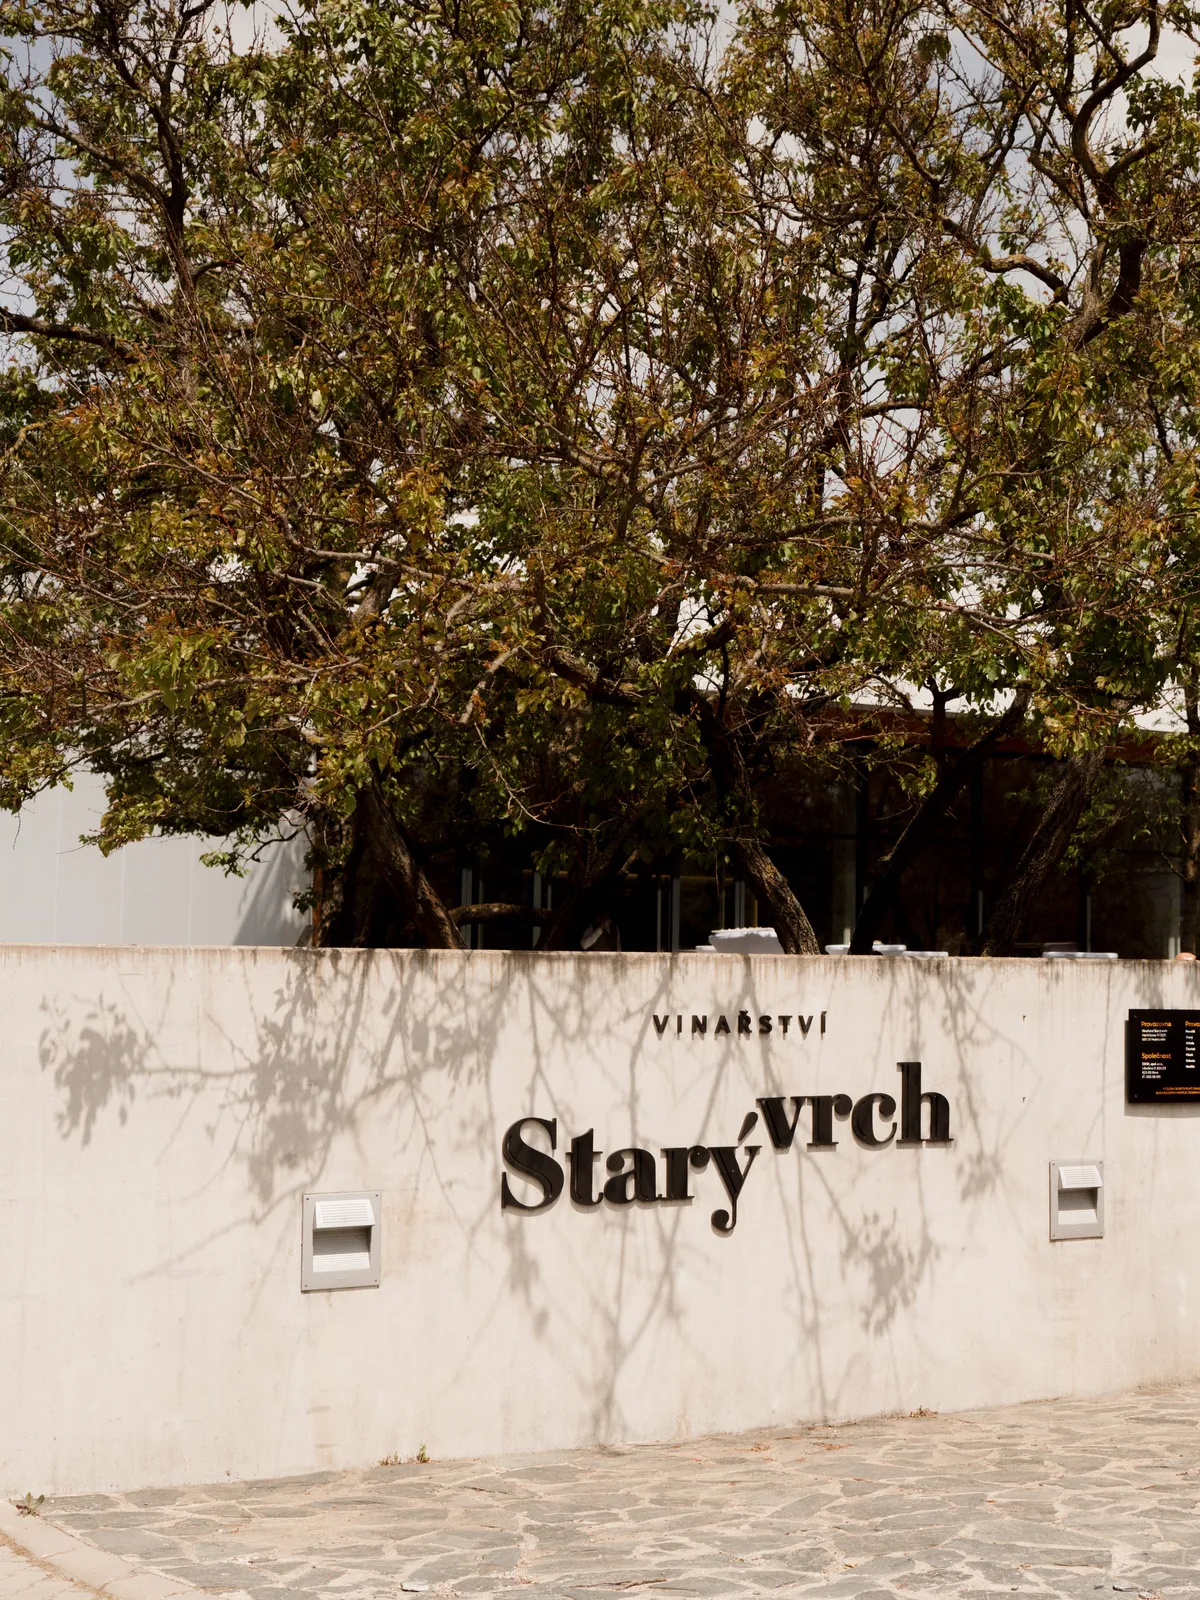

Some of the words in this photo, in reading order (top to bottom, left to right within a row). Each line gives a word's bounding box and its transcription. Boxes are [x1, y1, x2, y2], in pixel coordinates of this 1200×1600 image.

[653, 1010, 828, 1035] VINAŘSTVÍ
[1141, 1052, 1171, 1060] Společnost
[501, 1111, 762, 1232] Starý
[756, 1061, 954, 1149] vrch
